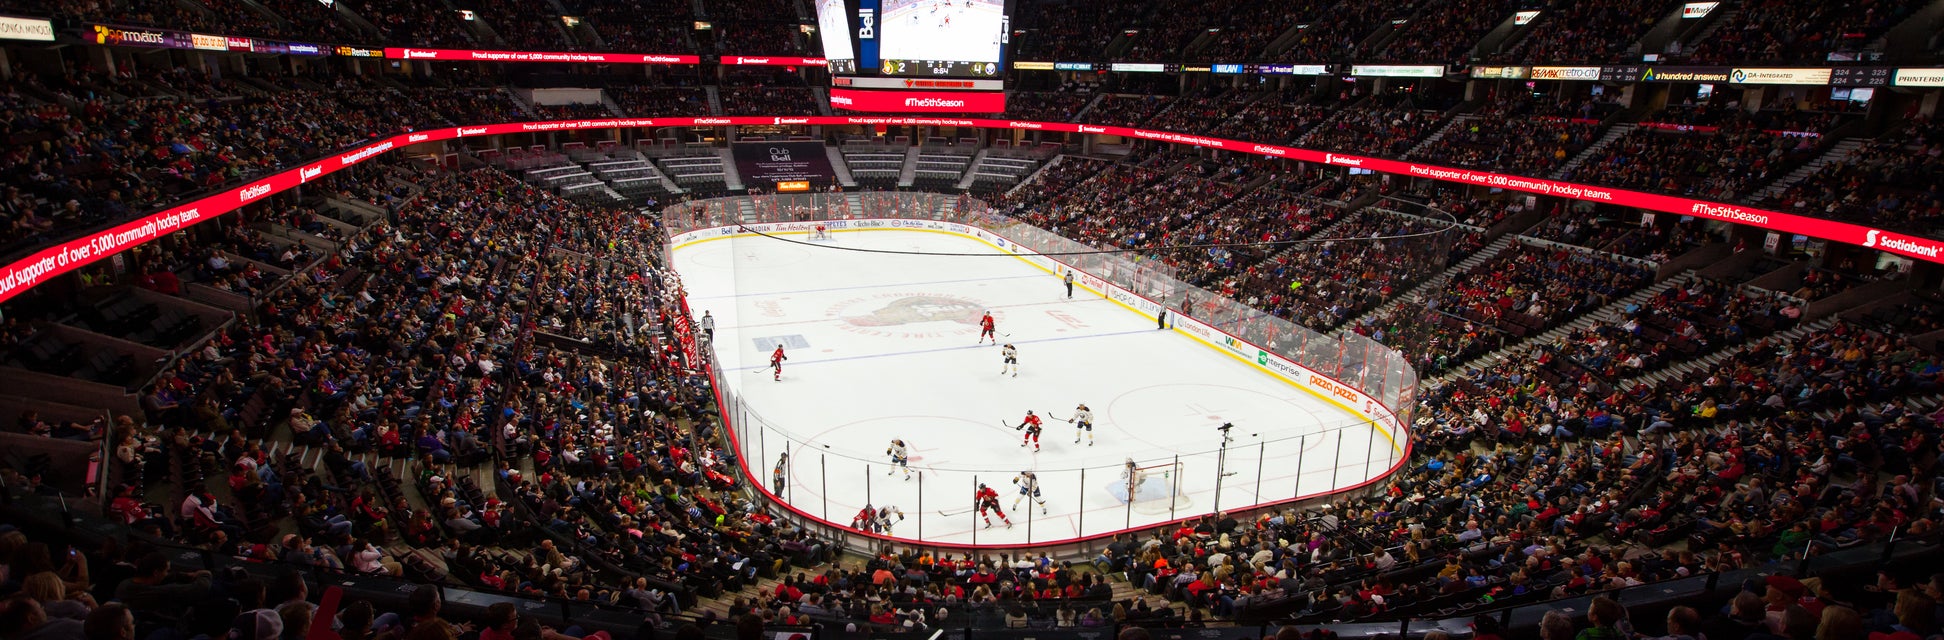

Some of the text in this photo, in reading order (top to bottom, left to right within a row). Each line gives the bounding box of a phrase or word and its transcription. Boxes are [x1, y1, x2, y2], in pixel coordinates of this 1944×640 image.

[0, 22, 24, 33] ONICA
[859, 9, 874, 39] Bell
[1532, 69, 1560, 78] RE/MAX
[1661, 72, 1693, 80] hundred
[1694, 73, 1727, 81] answers
[905, 98, 964, 107] #The5thSeason
[770, 147, 790, 155] Club
[771, 154, 791, 162] Bell
[1332, 156, 1361, 165] Scotiabank
[1410, 165, 1429, 174] Proud
[1430, 169, 1461, 178] supporter
[1462, 171, 1470, 180] of
[1488, 175, 1507, 185] 5,000
[1508, 179, 1552, 193] community
[1553, 183, 1582, 198] hockey
[1584, 189, 1612, 200] teams.
[1692, 203, 1768, 224] #The5thSeason
[0, 269, 16, 294] oud
[16, 256, 56, 286] supporter
[58, 247, 69, 267] of
[71, 245, 91, 262] over
[91, 233, 115, 256] 5,000
[116, 220, 156, 247] community
[156, 213, 181, 233] hockey
[180, 208, 200, 222] teams.
[1880, 236, 1938, 258] Scotiabank
[1184, 321, 1202, 334] London
[1225, 335, 1243, 351] WM
[1262, 356, 1300, 377] enterprise
[1309, 375, 1358, 403] pizza pizza
